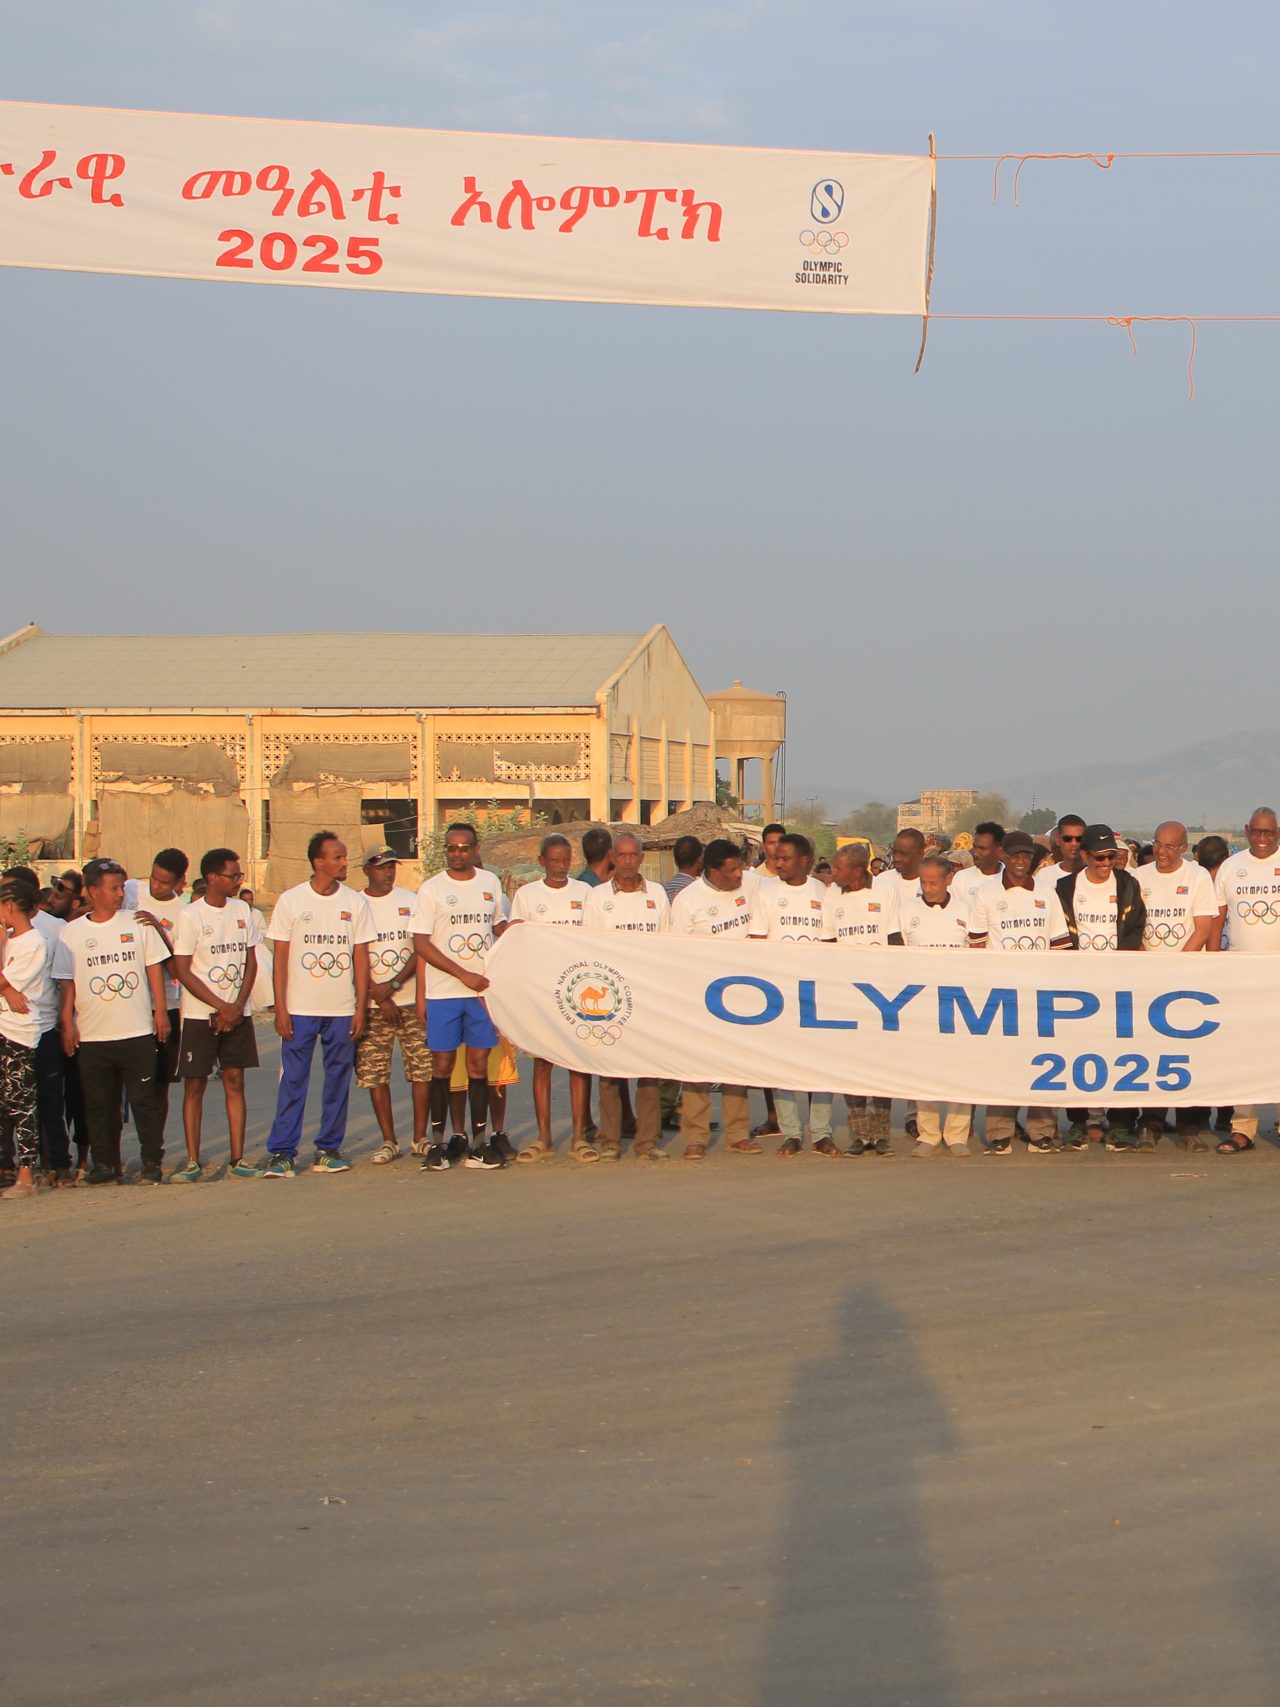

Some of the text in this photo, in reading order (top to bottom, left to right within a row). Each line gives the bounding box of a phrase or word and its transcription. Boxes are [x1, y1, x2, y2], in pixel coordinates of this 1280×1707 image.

[0, 150, 125, 207] ራዊ
[182, 165, 402, 225] መዓልቲ
[216, 229, 383, 275] 2025
[803, 260, 842, 273] OLYMPIC
[795, 272, 849, 285] SOLIDARITY
[1237, 885, 1268, 895] OLYMPIC
[451, 914, 481, 924] OLYMPIC
[1078, 913, 1106, 923] OLYMPIC
[1173, 908, 1186, 917] DAY
[712, 917, 739, 933] OLYMPIC
[781, 916, 809, 926] OLYMPIC
[1001, 918, 1045, 929] OLYMPIC DAY
[838, 926, 864, 937] OLYMPIC
[304, 934, 335, 944] OLYMPIC
[87, 951, 136, 967] OLYMPIC DAY
[555, 960, 633, 1026] ERITREAN NATIONAL OLYMPIC COMMITTEE
[704, 976, 1220, 1039] OLYMPIC
[1030, 1053, 1192, 1092] 2025
